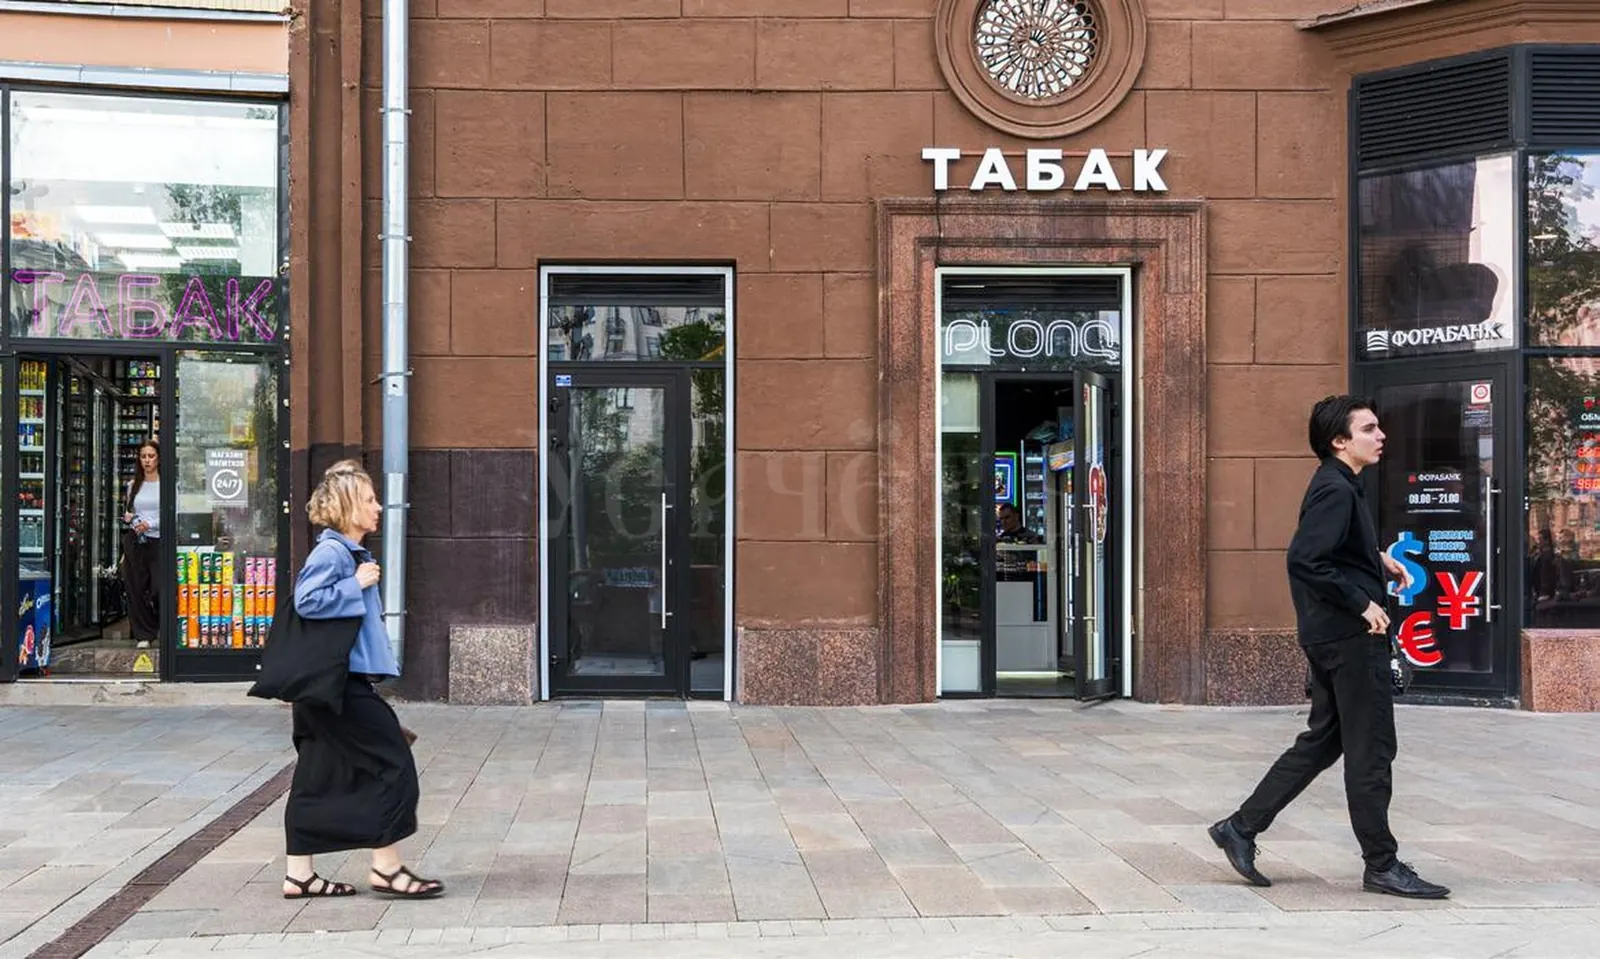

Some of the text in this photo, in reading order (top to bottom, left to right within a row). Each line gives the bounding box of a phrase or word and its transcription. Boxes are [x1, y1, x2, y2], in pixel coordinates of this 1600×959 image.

[921, 148, 1168, 192] ТАБАК
[11, 269, 275, 341] ТАБАК
[1391, 322, 1504, 346] ФОРАБАНК
[216, 479, 238, 489] 24/7
[1418, 473, 1461, 481] ФОРАБАНК
